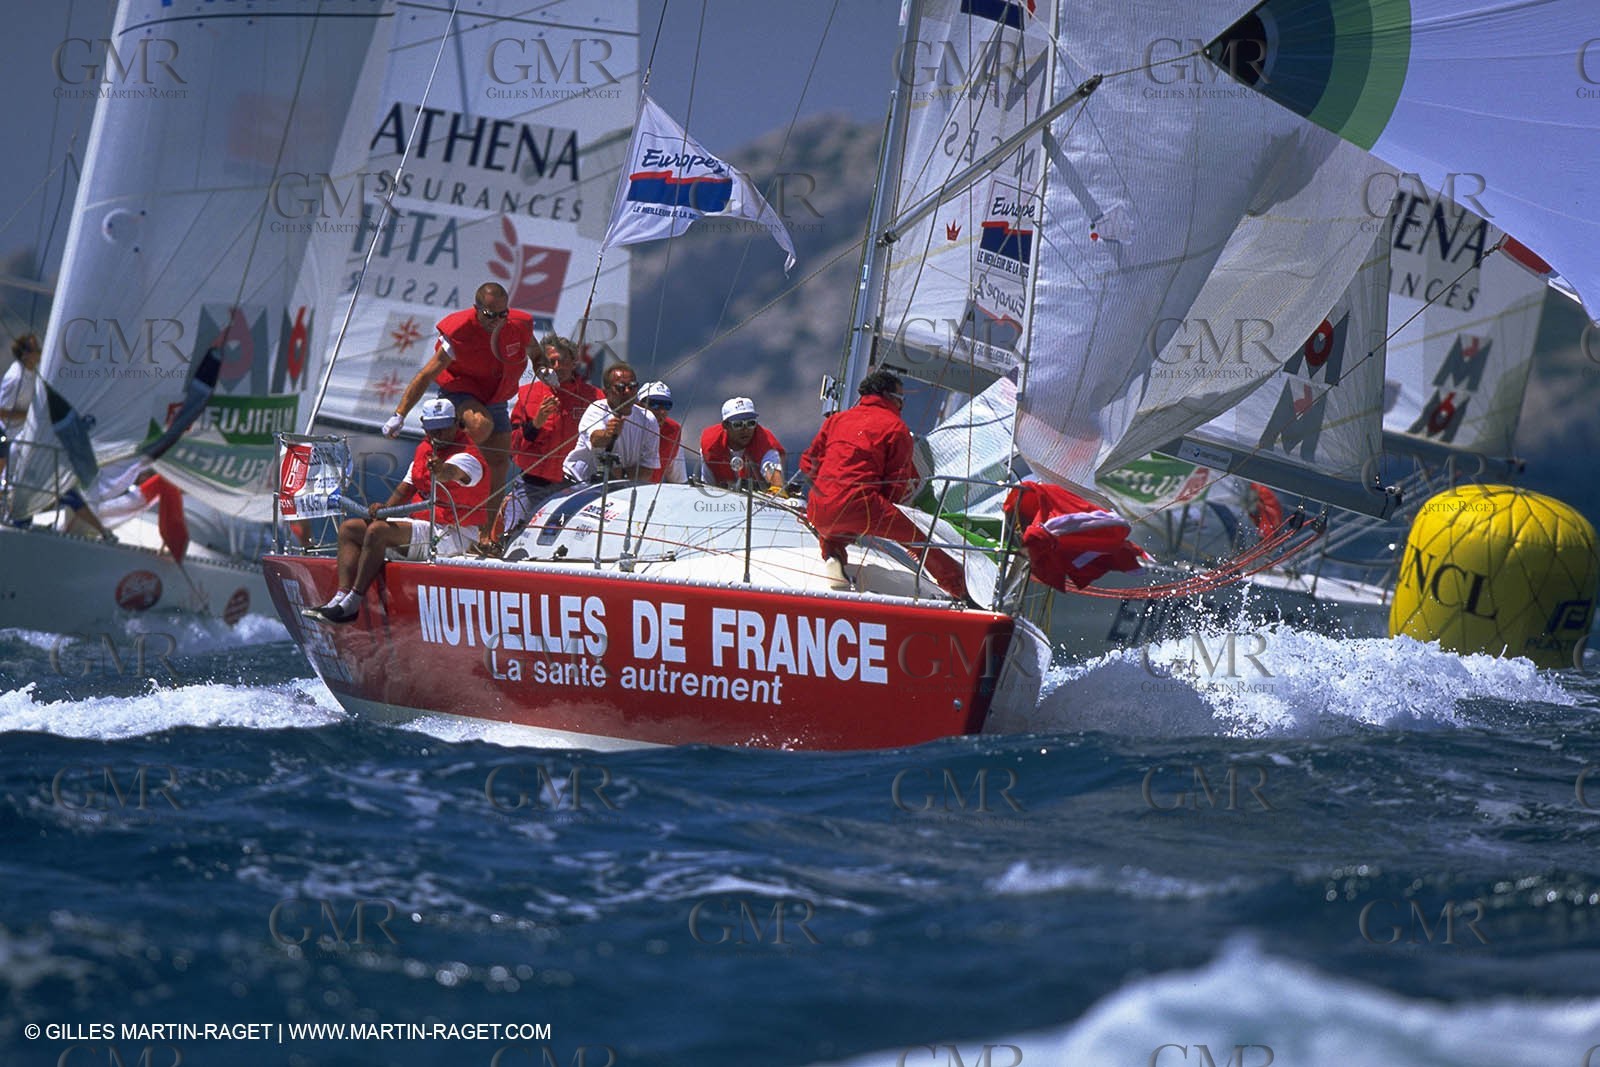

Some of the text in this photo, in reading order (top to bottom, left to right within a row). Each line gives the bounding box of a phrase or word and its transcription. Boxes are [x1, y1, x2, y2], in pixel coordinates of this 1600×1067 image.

[370, 101, 580, 182] ATHENA
[205, 404, 297, 435] FUJIFILM
[1400, 545, 1497, 620] NCL
[417, 584, 608, 657] MUTUELLES
[632, 599, 686, 663] DE
[712, 607, 888, 684] FRANCE
[491, 649, 783, 705] La santé autrement
